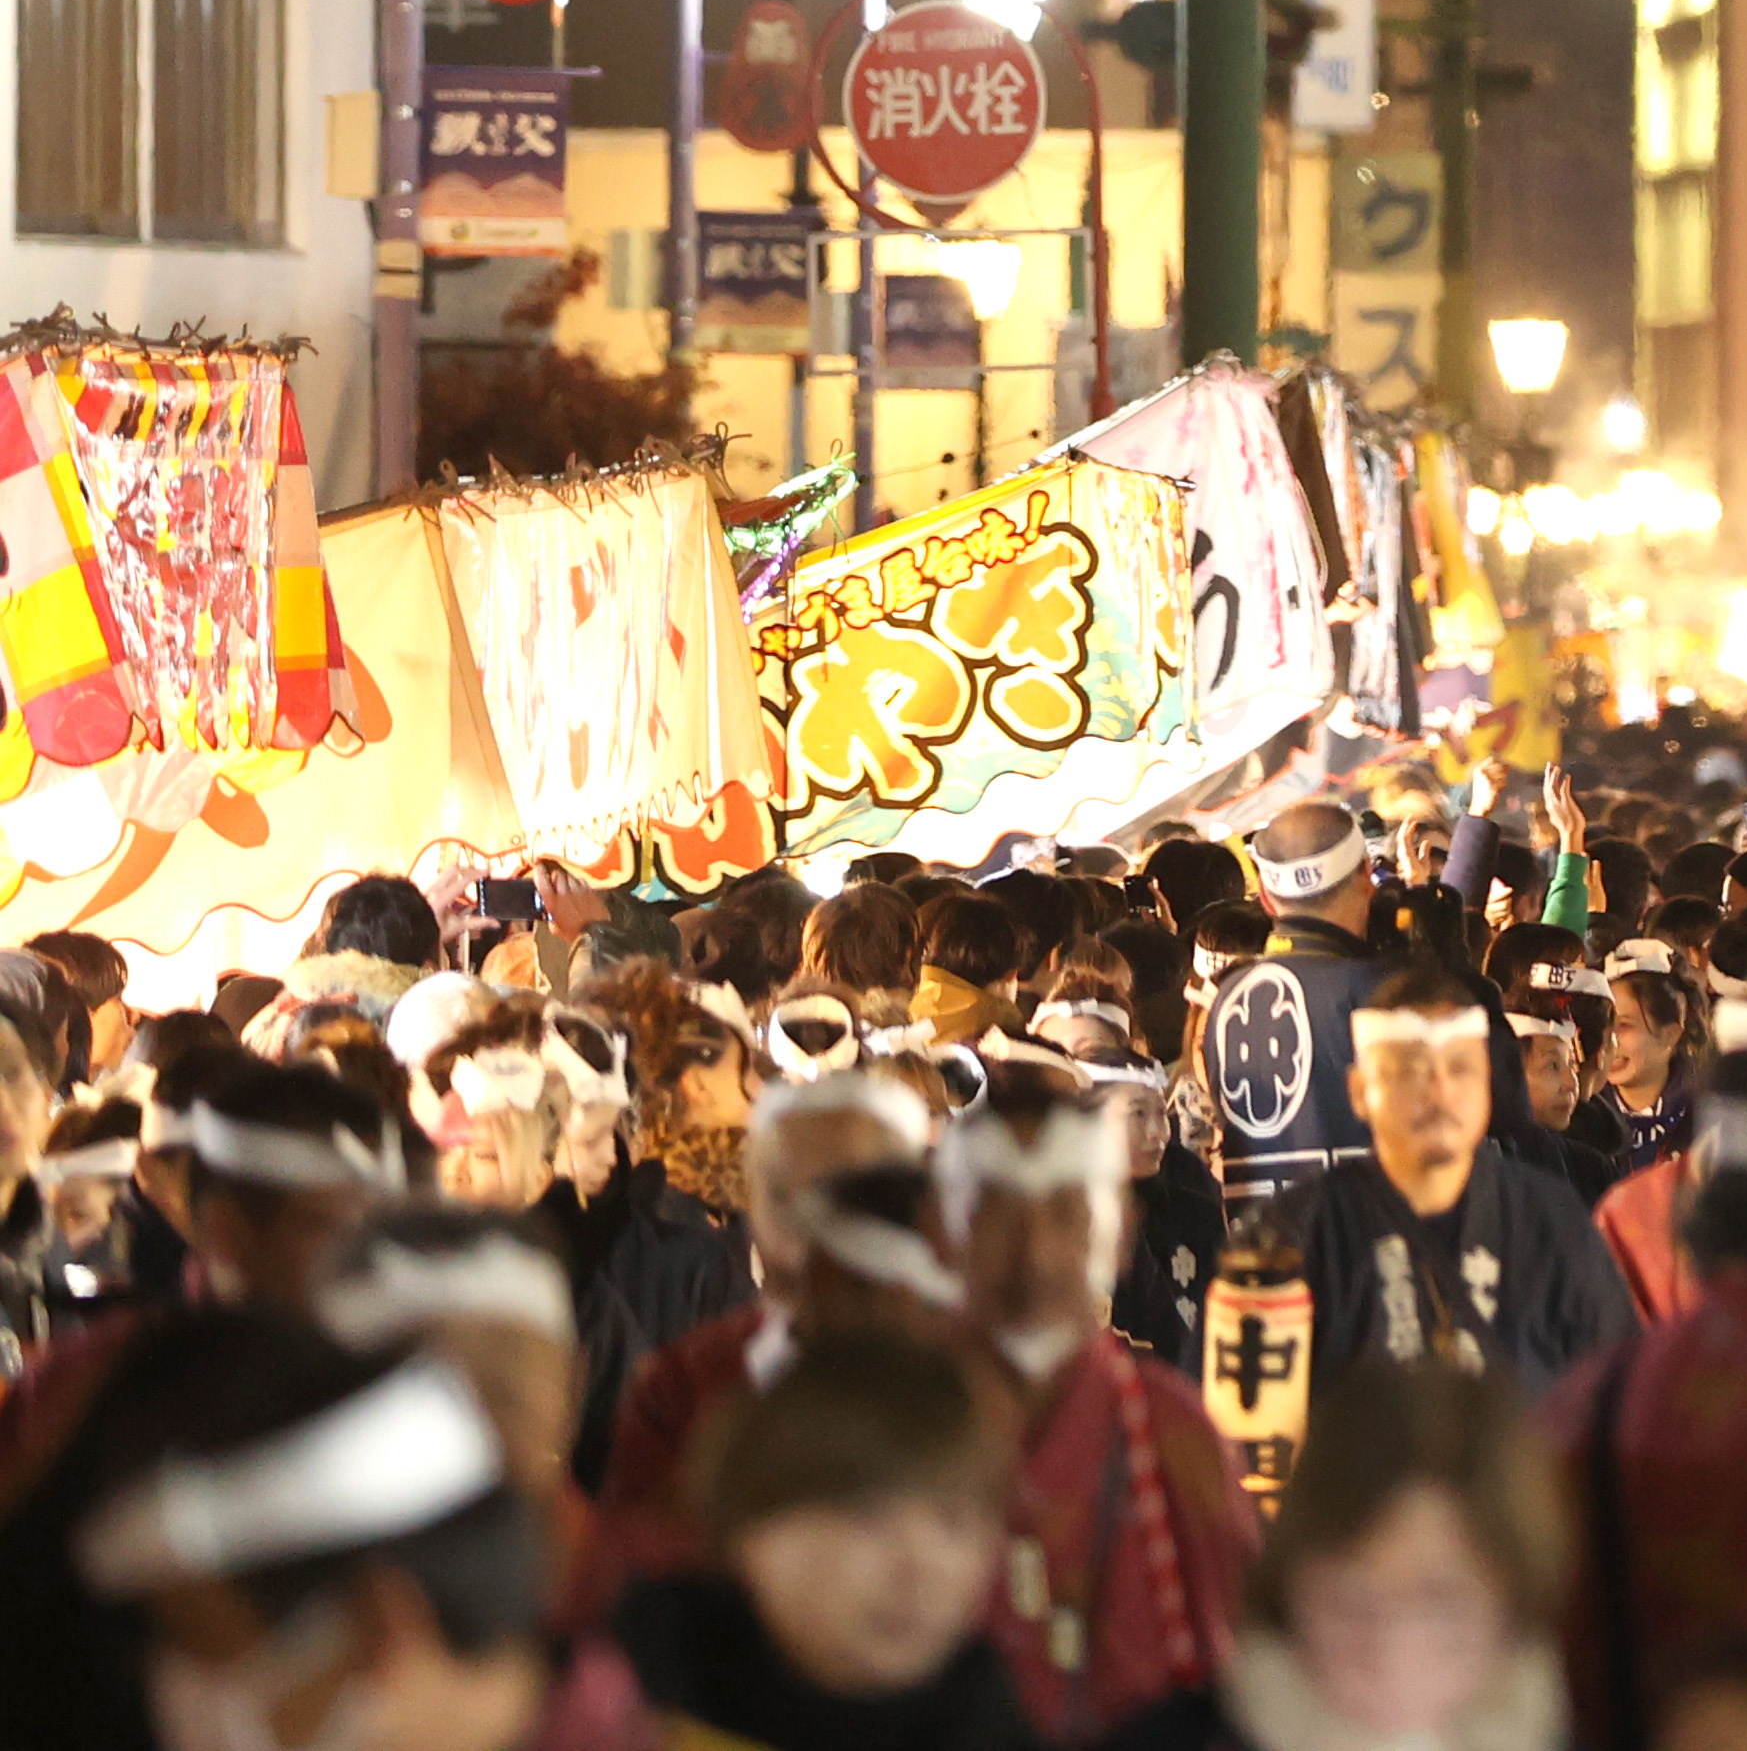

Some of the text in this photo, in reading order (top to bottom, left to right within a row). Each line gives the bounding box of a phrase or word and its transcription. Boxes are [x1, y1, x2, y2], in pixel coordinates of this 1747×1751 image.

[864, 62, 1027, 140] 消火栓
[1219, 977, 1300, 1126] 中
